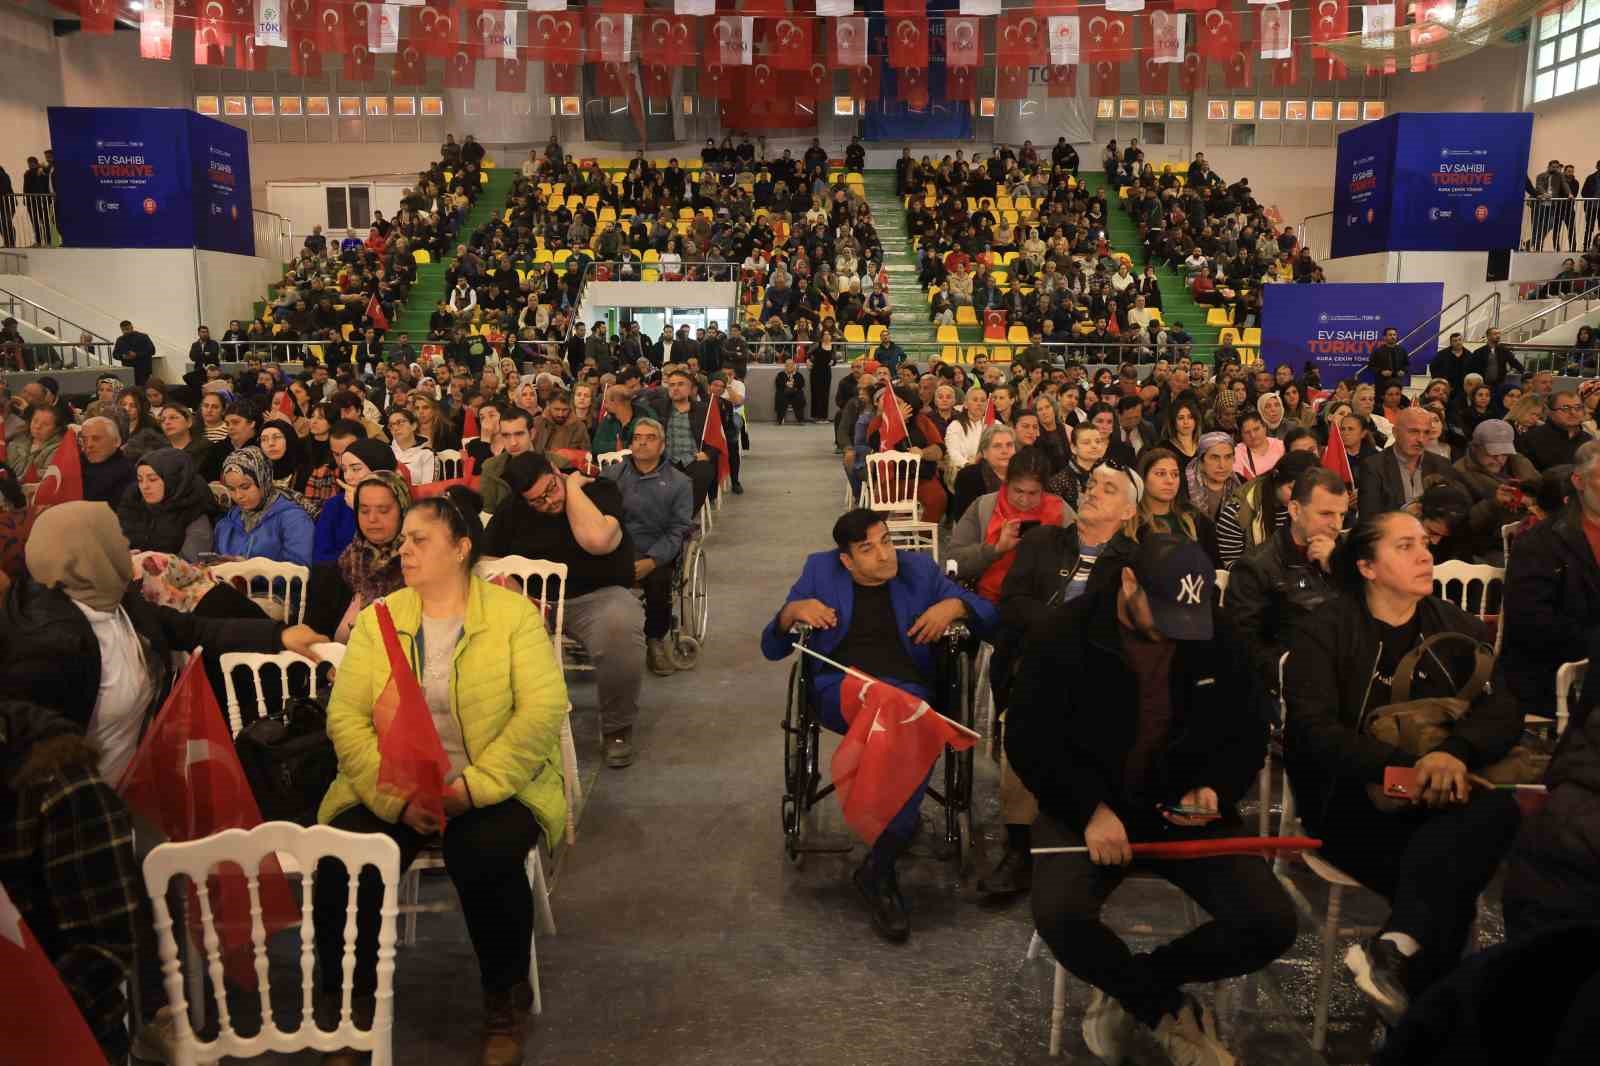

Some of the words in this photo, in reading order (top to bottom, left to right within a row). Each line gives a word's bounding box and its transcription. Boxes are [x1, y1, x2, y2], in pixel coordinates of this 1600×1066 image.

[97, 155, 111, 165] EV
[1439, 163, 1453, 173] EV
[1318, 330, 1335, 340] EV
[1337, 329, 1378, 340] SAHİBİ
